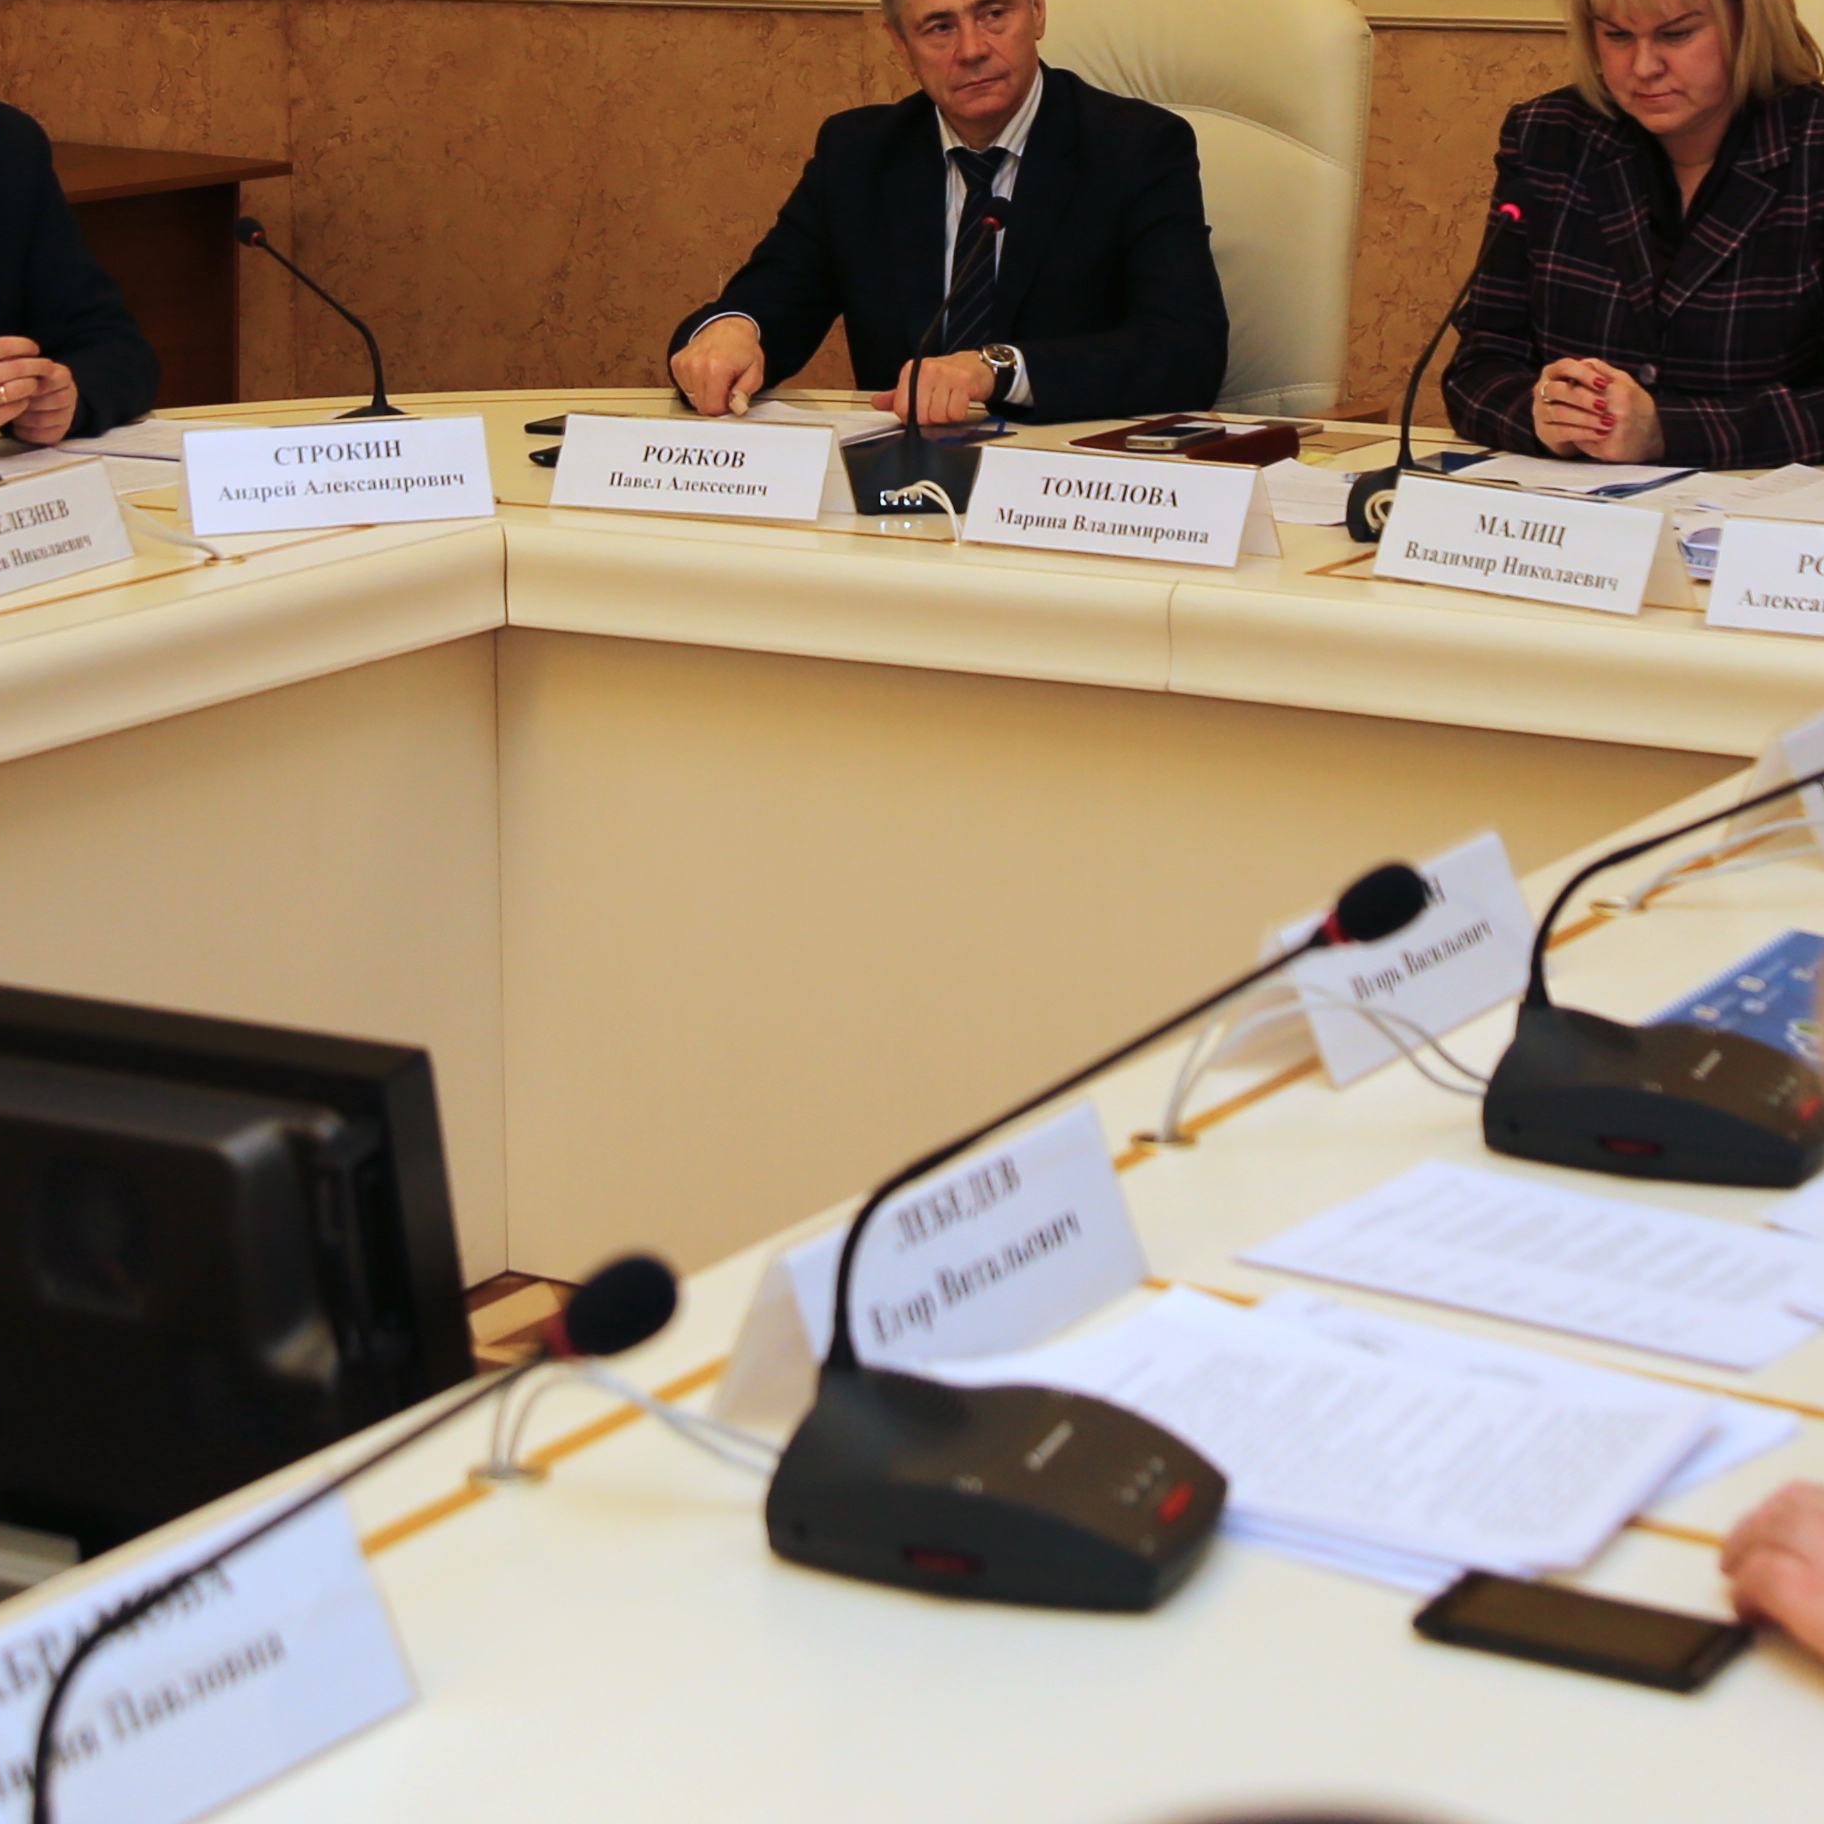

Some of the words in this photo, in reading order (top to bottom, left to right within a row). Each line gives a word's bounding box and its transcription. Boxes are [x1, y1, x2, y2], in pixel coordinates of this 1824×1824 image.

[274, 439, 402, 466] СТРОКИН
[642, 445, 746, 469] РОЖКОВ
[218, 479, 297, 503] Андрей
[304, 472, 465, 496] Александрович
[608, 470, 661, 490] Павел
[666, 477, 768, 496] Алексеевич
[1041, 476, 1179, 508] ТОМИЛОВА
[995, 506, 1067, 531] Марина
[1073, 514, 1210, 544] Владимировна
[1474, 513, 1567, 549] МАЛИЦ
[10, 534, 93, 567] Николаевич
[1404, 540, 1497, 576] Владимир
[1502, 555, 1619, 591] Николаевич
[1350, 966, 1404, 1000] Игорь
[1403, 919, 1494, 976] Васильевич
[895, 1154, 1023, 1253] ЛЕБЕДЕВ
[869, 1290, 938, 1345] Егор
[935, 1207, 1083, 1308] Витальевич
